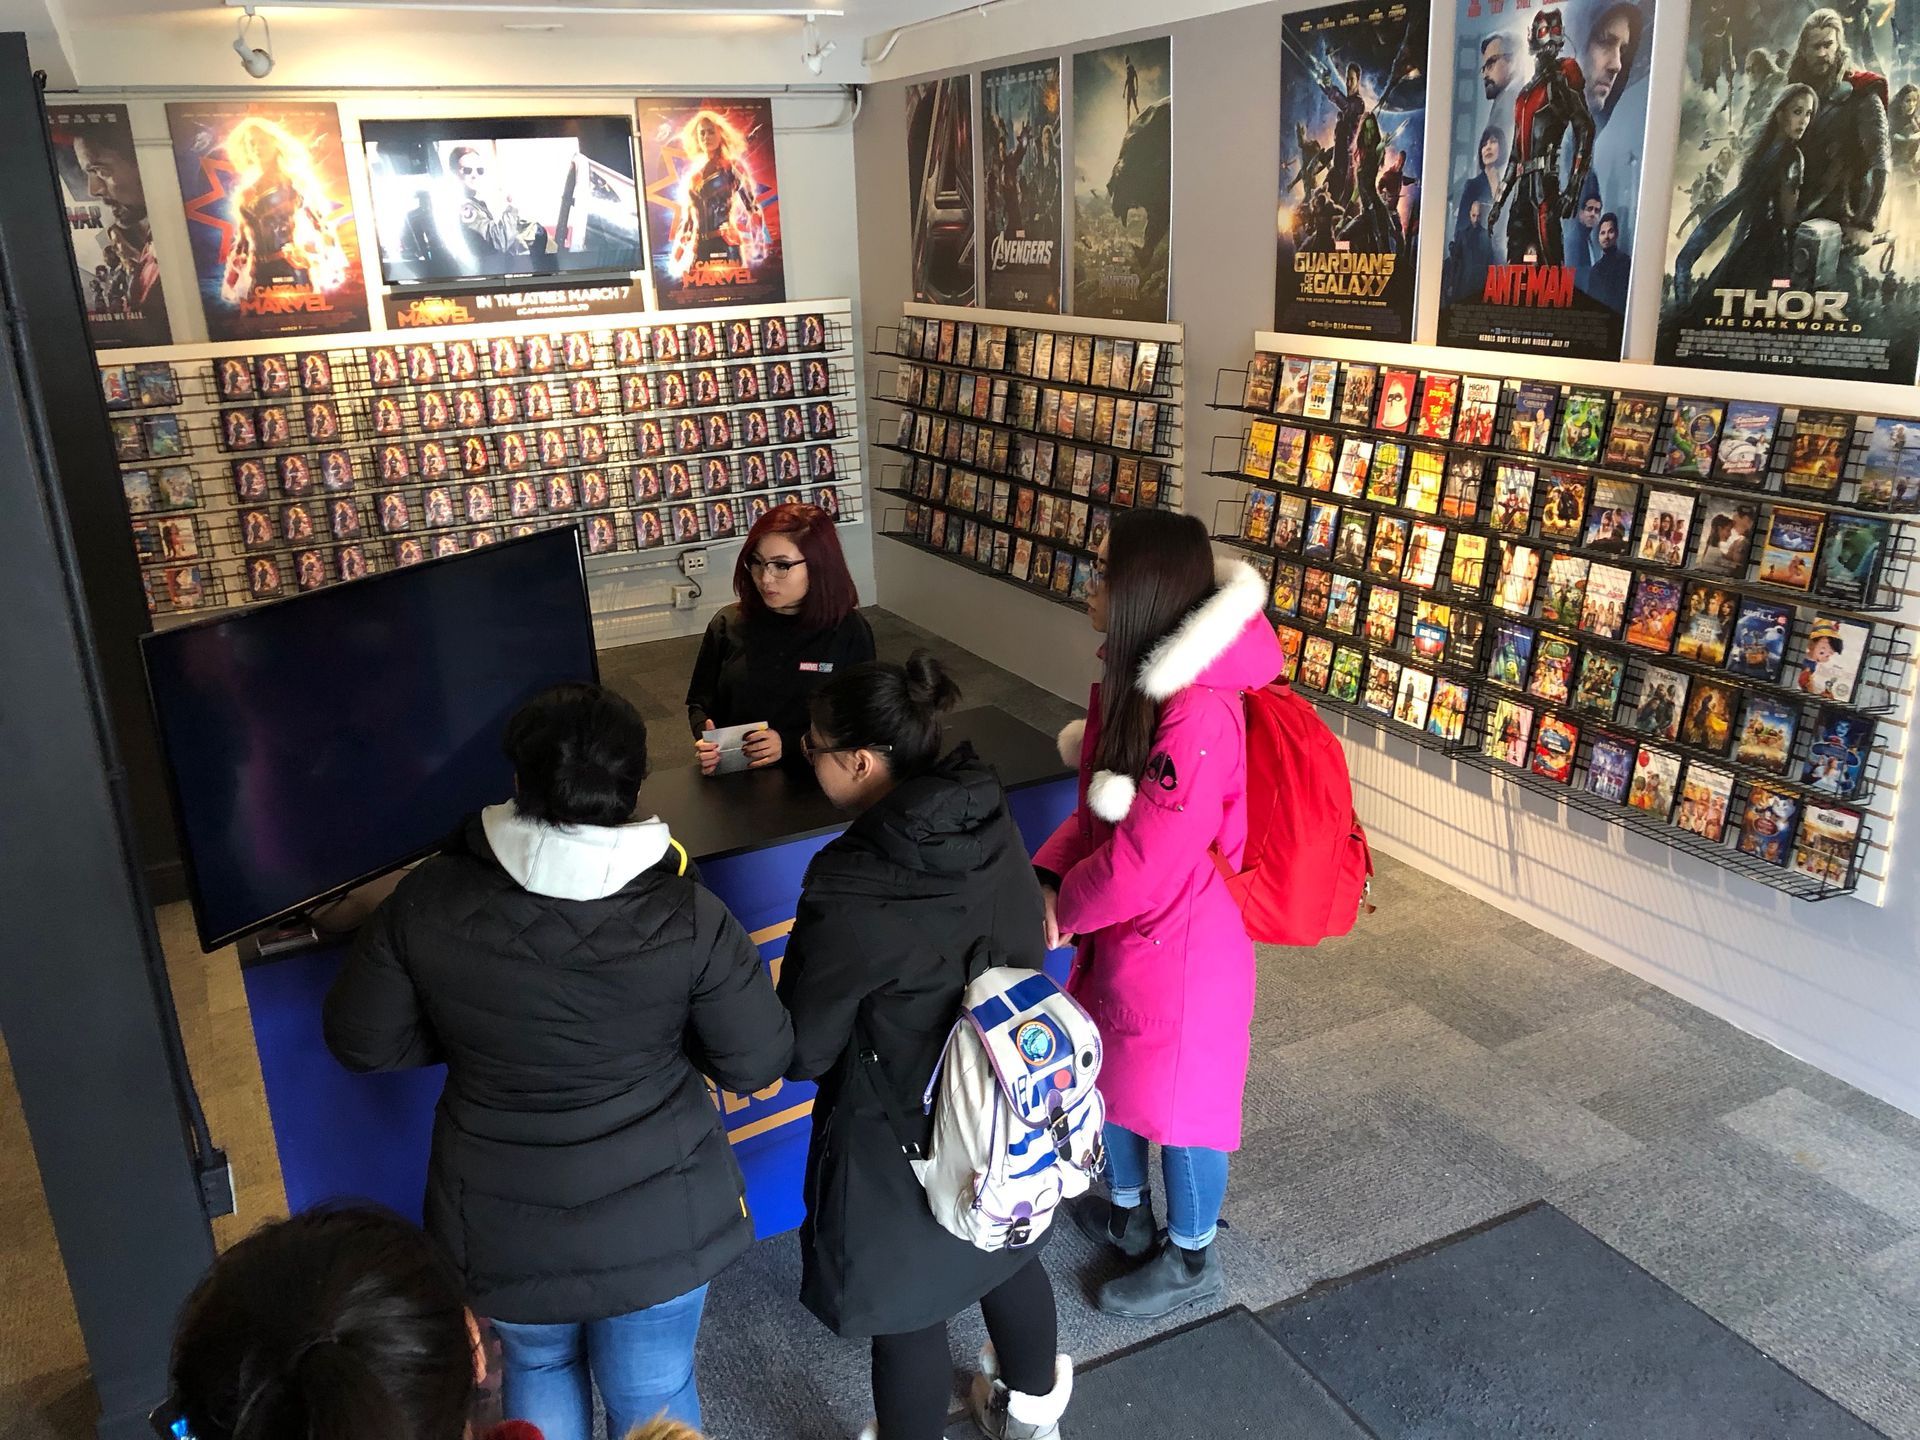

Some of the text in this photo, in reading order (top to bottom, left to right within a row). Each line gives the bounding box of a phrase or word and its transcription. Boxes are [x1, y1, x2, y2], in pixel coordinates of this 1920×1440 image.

[991, 231, 1054, 271] AVENGERS
[1294, 252, 1397, 275] GUARDIANS
[682, 269, 758, 290] MARVEL
[1300, 273, 1391, 297] THE GALAXY
[1304, 274, 1314, 283] OF
[1483, 264, 1577, 308] ANT-MAN
[240, 294, 334, 316] MARVEL
[476, 286, 630, 309] IN THEATRES MARCH 7
[1713, 288, 1850, 321] THOR
[398, 306, 476, 328] MARVEL
[1704, 317, 1863, 332] THE DARK WORLD
[1497, 335, 1511, 343] DON'T
[1512, 336, 1521, 344] GET
[1532, 338, 1550, 346] BIGGER
